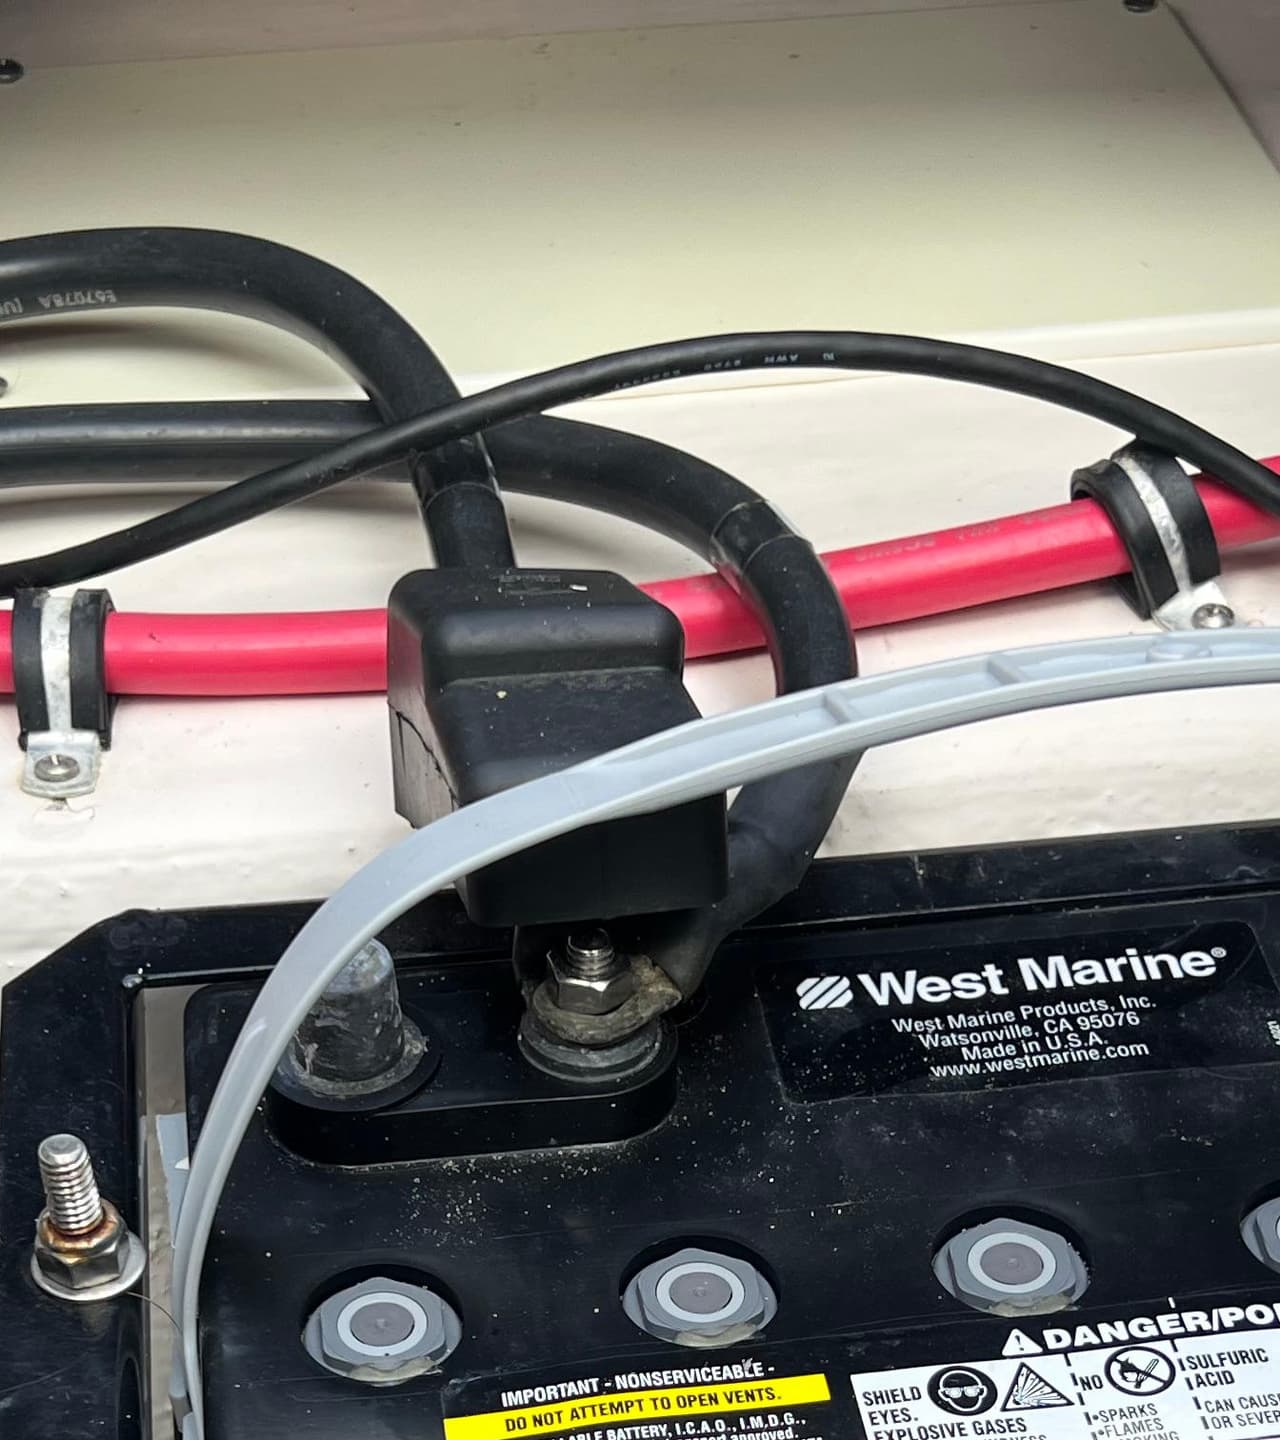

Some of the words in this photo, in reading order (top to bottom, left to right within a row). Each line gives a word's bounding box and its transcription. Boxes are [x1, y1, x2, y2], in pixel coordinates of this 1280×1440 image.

[857, 963, 1010, 1006] West
[891, 1017, 944, 1034] West
[947, 1010, 1016, 1030] Marine
[1020, 998, 1115, 1020] Products,
[1119, 994, 1157, 1010] Inc.
[918, 1025, 1040, 1050] Watsonville,
[1043, 1017, 1074, 1035] CA
[1078, 1011, 1140, 1031] 95076
[961, 1041, 1017, 1062] Made
[1021, 1039, 1041, 1053] in
[1045, 1031, 1109, 1050] U.S.A.
[930, 1042, 1150, 1078] www.westmarine.com
[1187, 1348, 1269, 1370] SULFURIC
[501, 1377, 600, 1408] IMPORTANT
[615, 1363, 764, 1390] NONSERVICEABLE
[1078, 1374, 1104, 1391] NO
[1196, 1370, 1235, 1388] ACID
[862, 1386, 922, 1407] SHIELD
[1204, 1397, 1235, 1414] CAN
[505, 1416, 527, 1432] DO
[533, 1410, 564, 1428] NOT
[570, 1399, 645, 1421] ATTEMPT
[649, 1396, 671, 1411] TO
[676, 1392, 719, 1408] OPEN
[723, 1387, 782, 1404] VENTS.
[868, 1407, 919, 1427] EYES.
[973, 1417, 1027, 1435] GASES
[1211, 1414, 1233, 1429] OR
